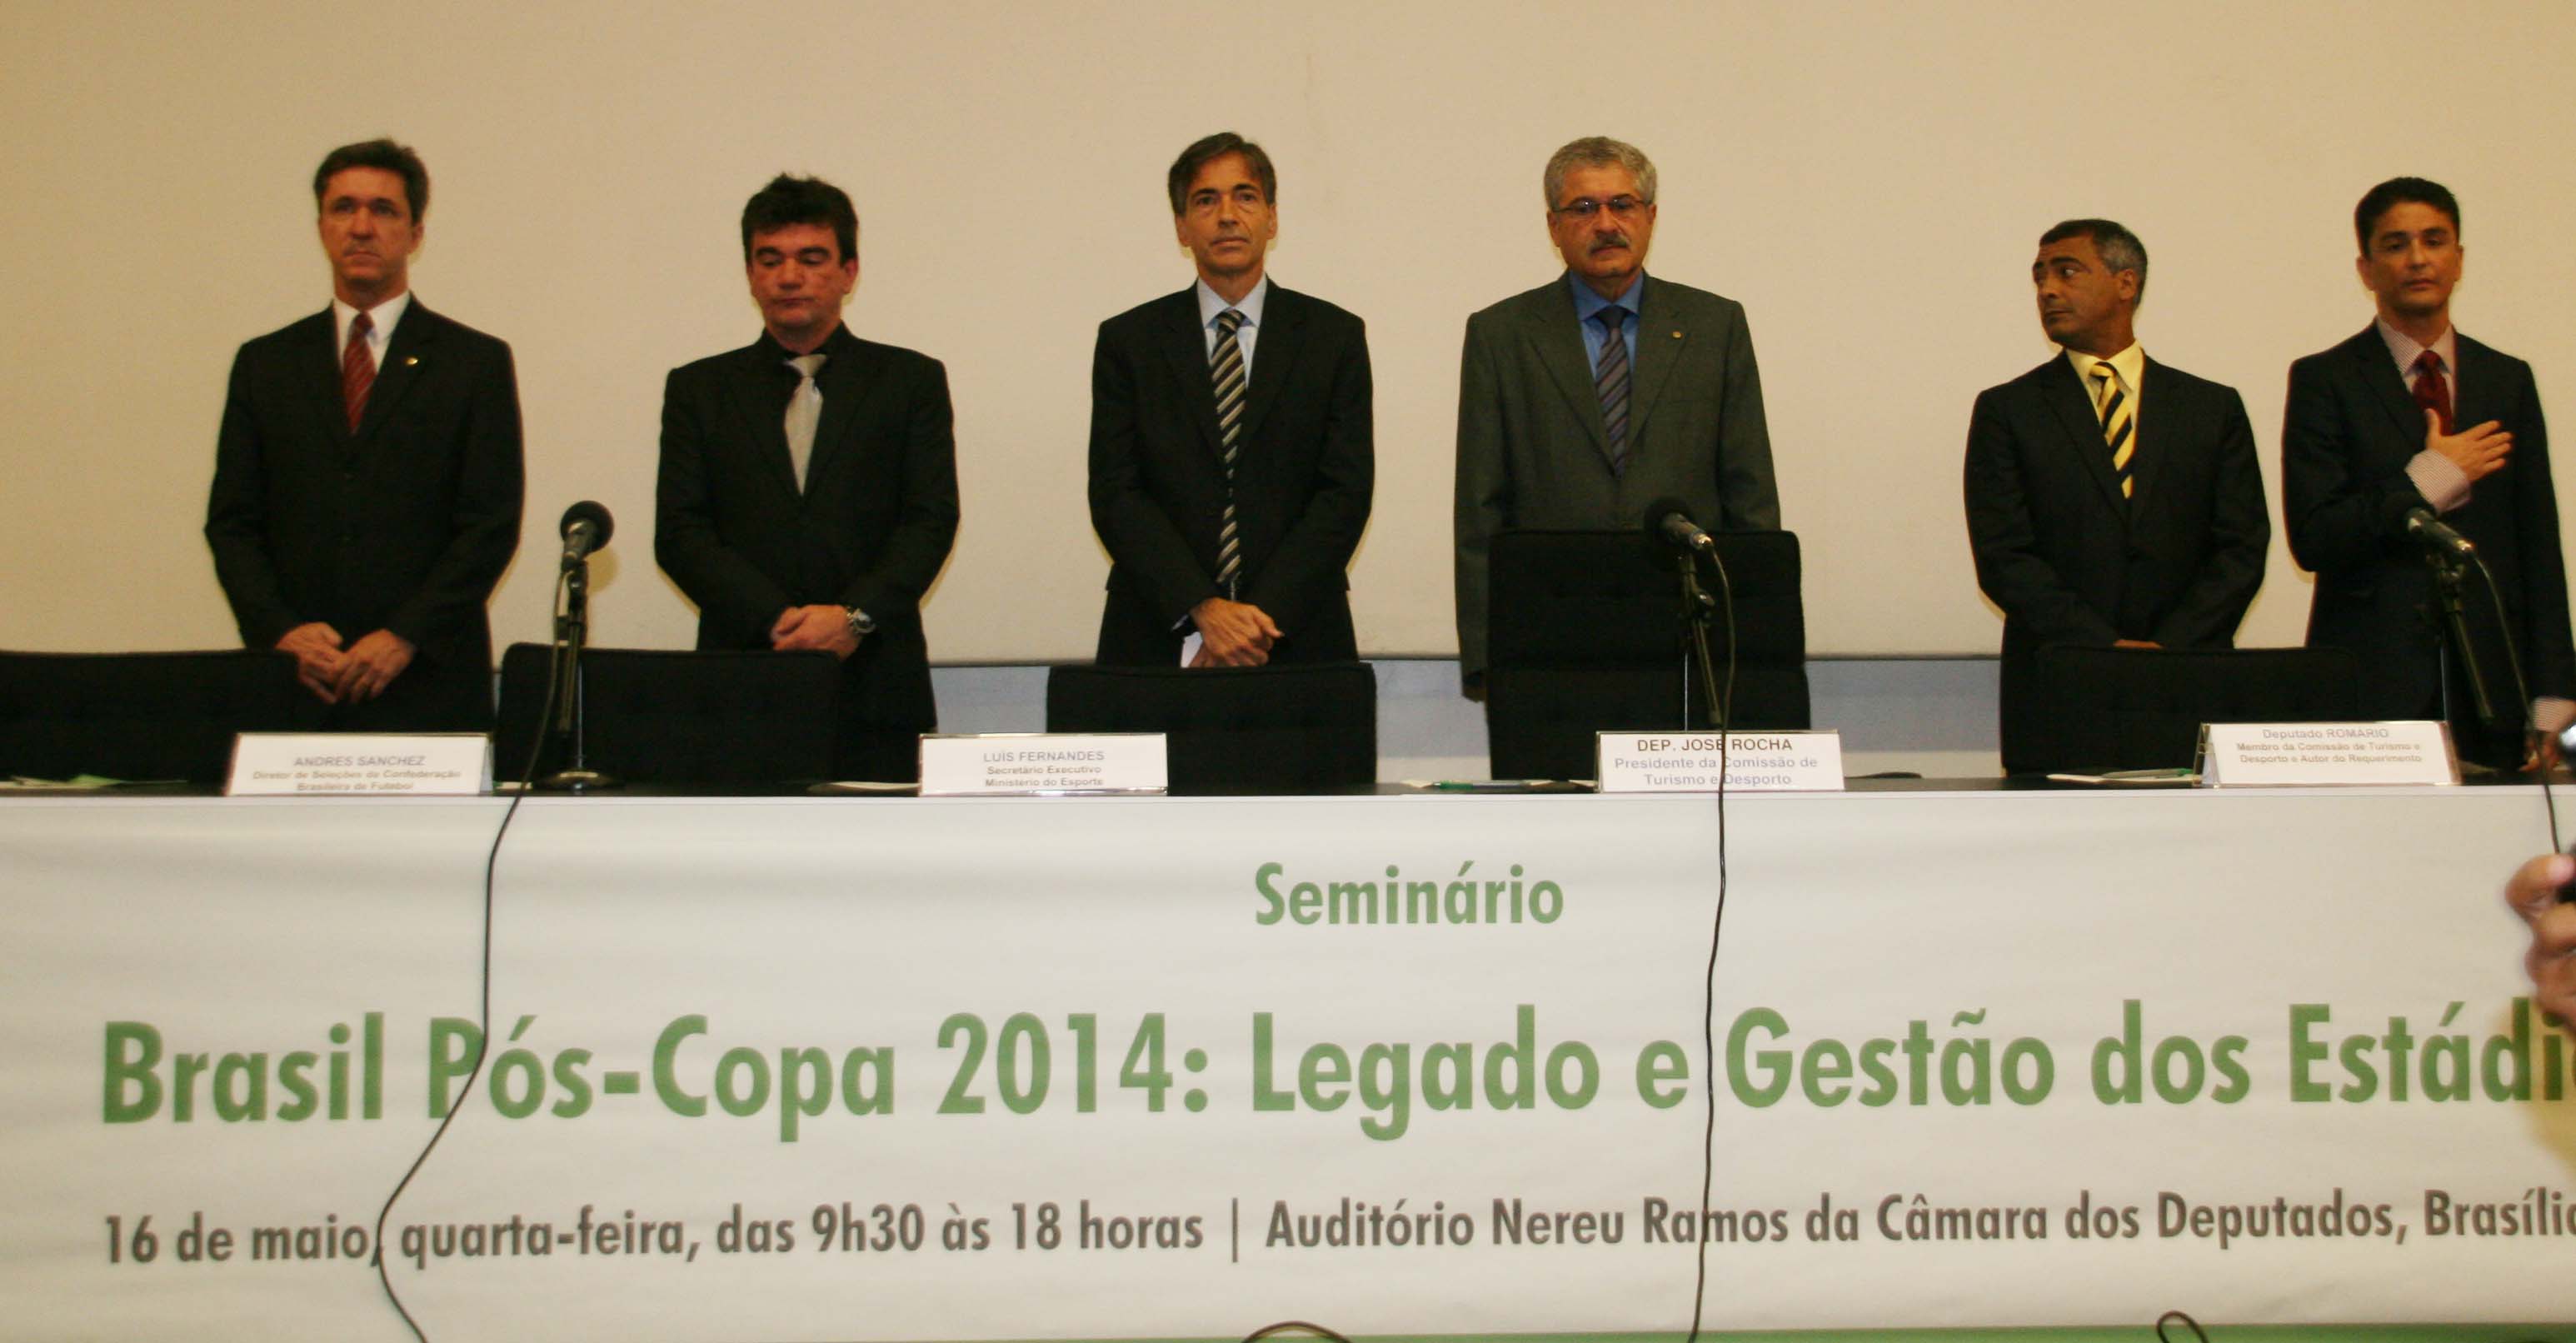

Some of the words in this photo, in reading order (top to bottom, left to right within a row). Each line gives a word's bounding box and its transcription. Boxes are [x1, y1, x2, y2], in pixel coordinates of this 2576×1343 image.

[2263, 729, 2322, 740] Deputado
[1637, 739, 1676, 751] DEP.
[1731, 738, 1793, 751] ROCHA
[357, 755, 426, 766] SANCHEZ
[1019, 751, 1105, 761] FERNANDES
[1615, 757, 1694, 768] Presidente
[1699, 756, 1716, 768] da
[1724, 756, 1795, 767] Comissão
[1800, 756, 1817, 767] de
[1047, 765, 1101, 774] Executivo
[1645, 773, 1705, 785] Turismo
[1711, 776, 1719, 785] e
[1723, 773, 1791, 786] Desporto
[1255, 861, 1565, 926] Seminário
[102, 1011, 384, 1124] Brasil
[427, 1013, 895, 1142] Pós-Copa
[936, 1012, 1208, 1115] 2014:
[1252, 1005, 1600, 1141] Legado
[1636, 1041, 1690, 1110] e
[1725, 1007, 2056, 1109] Gestão
[2090, 999, 2251, 1106] dos
[2289, 997, 2576, 1104] Estádi
[105, 1215, 159, 1265] 16
[176, 1211, 234, 1263] de
[401, 1205, 701, 1271] quarta-feira,
[716, 1203, 796, 1254] das
[811, 1201, 926, 1253] 9h30
[941, 1203, 991, 1251] às
[1011, 1201, 1062, 1251] 18
[1080, 1200, 1204, 1250] horas
[1266, 1197, 1475, 1248] Auditório
[1492, 1198, 1625, 1246] Nereu
[1643, 1196, 1789, 1244] Ramos
[1805, 1192, 1860, 1242] da
[1876, 1193, 2048, 1241] Câmara
[2064, 1190, 2140, 1240] dos
[2157, 1188, 2408, 1251] Deputados,
